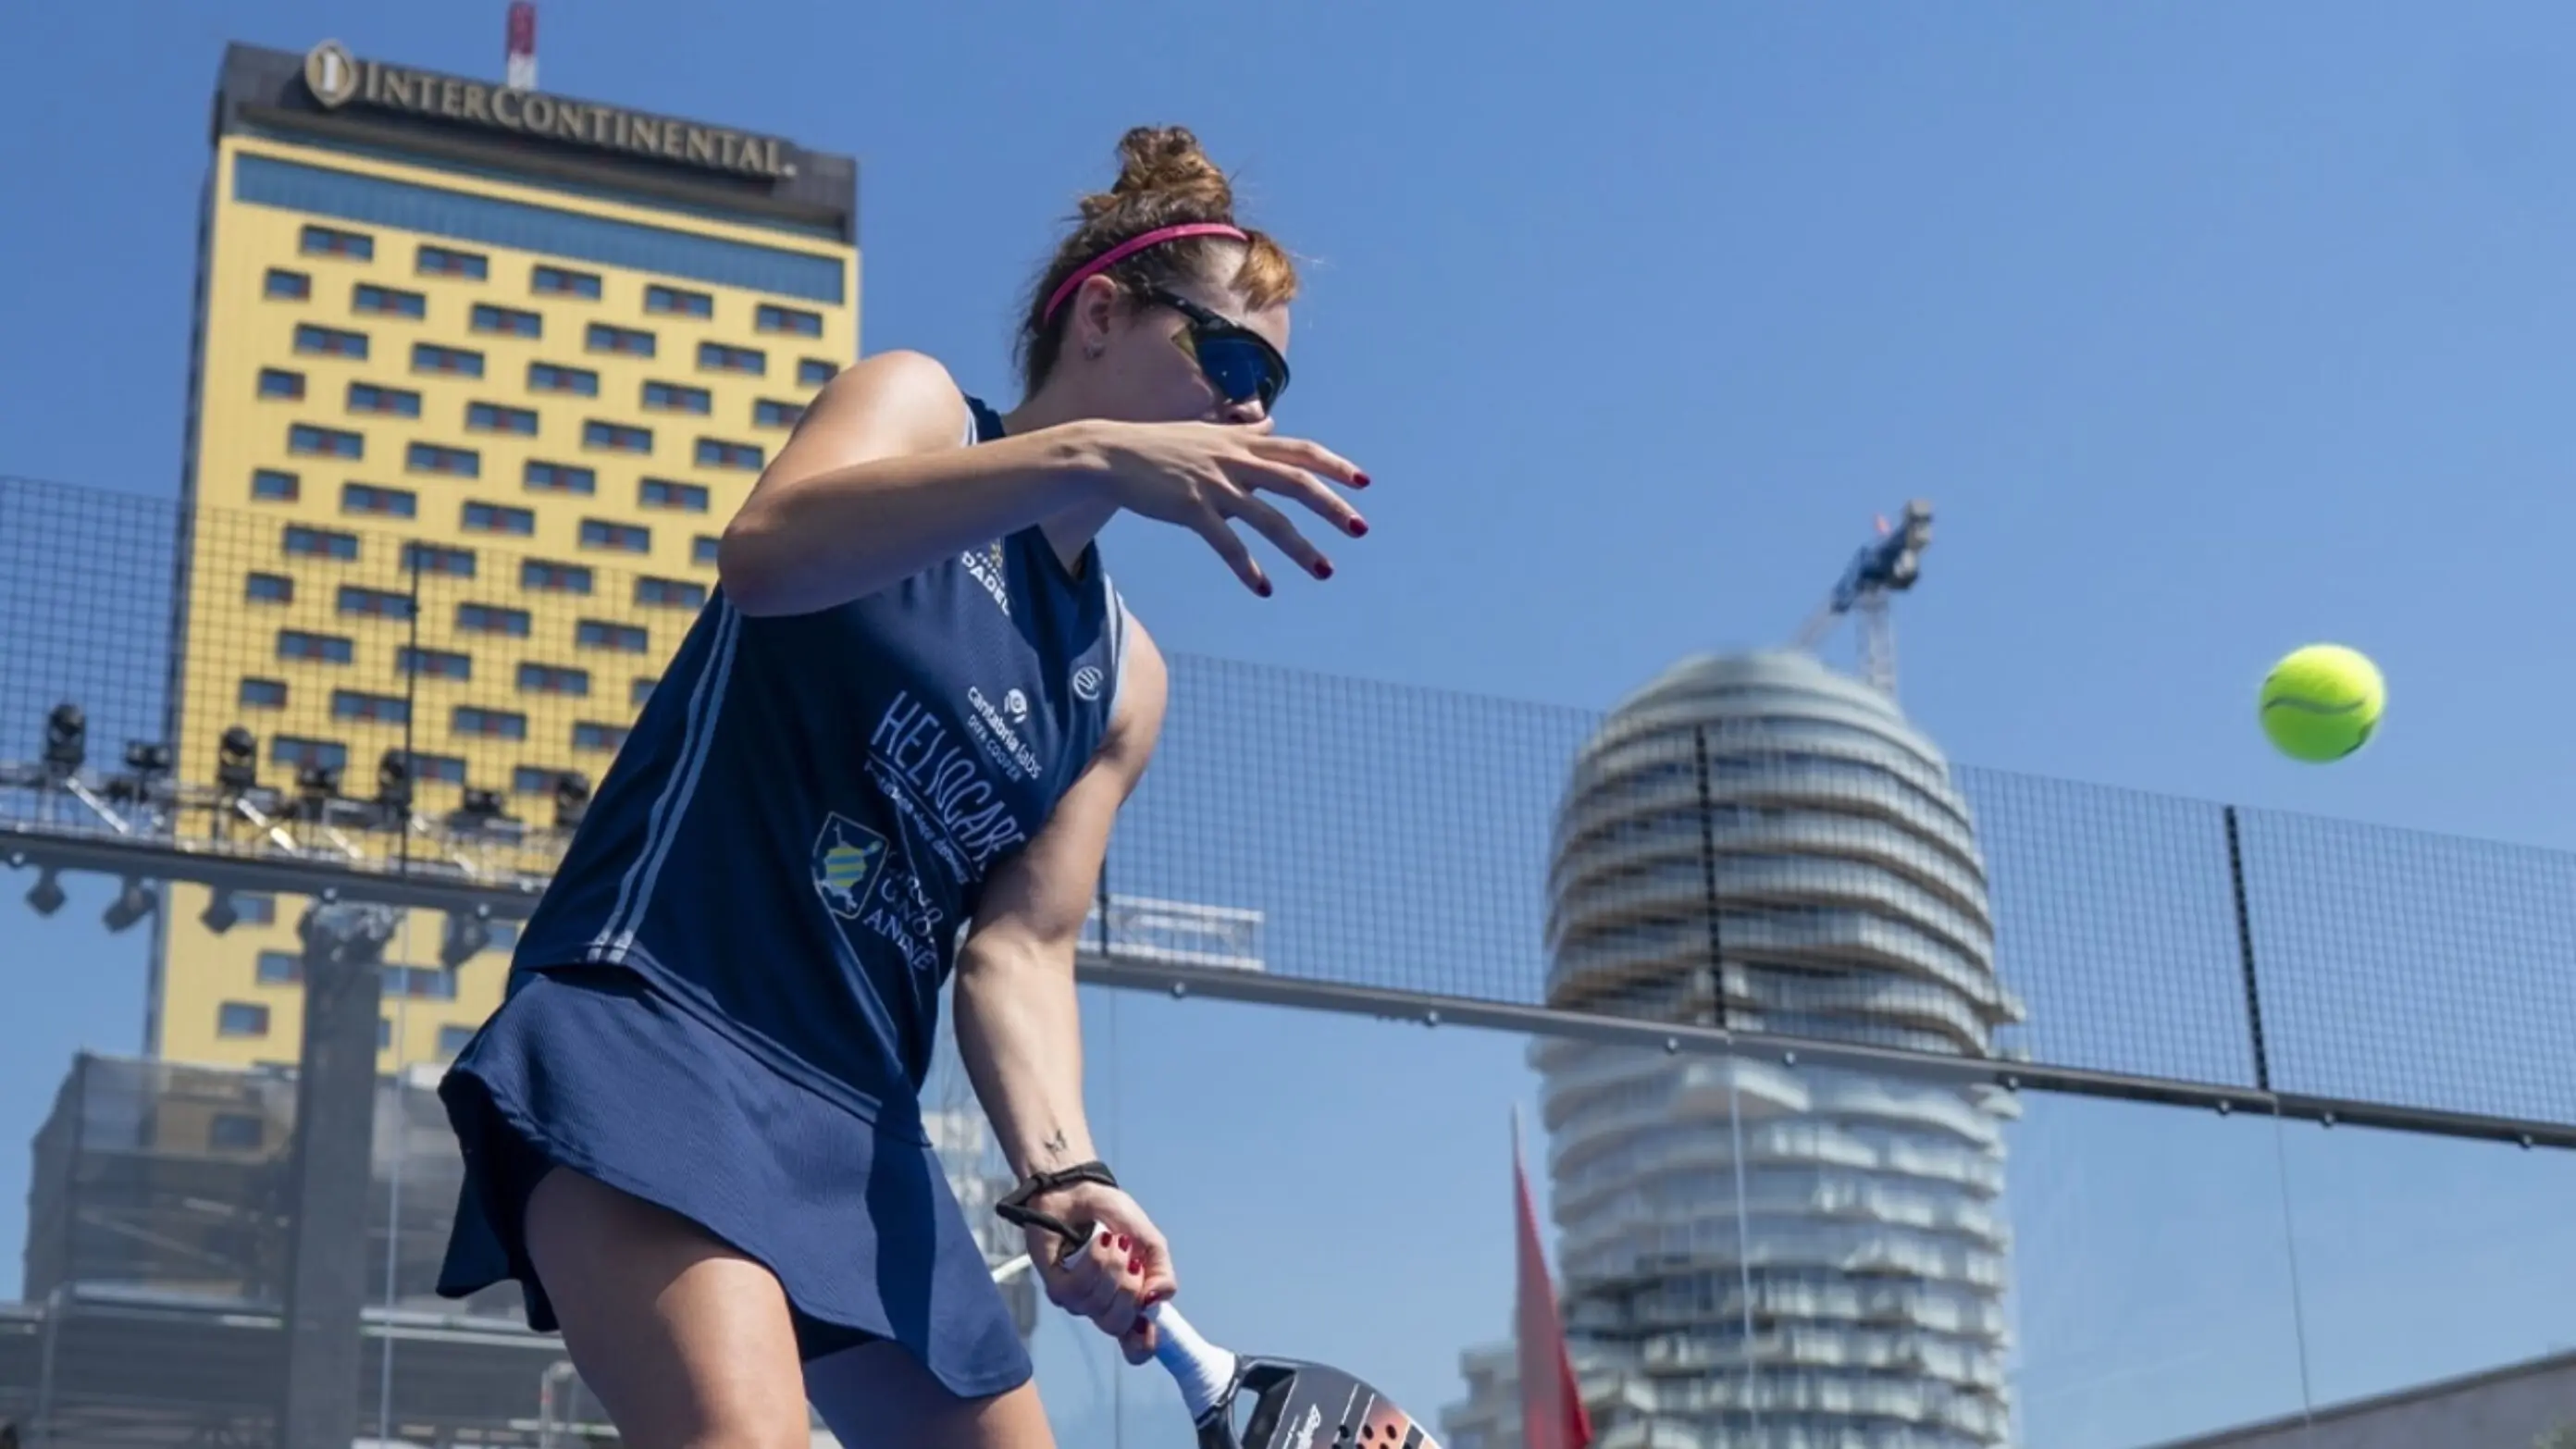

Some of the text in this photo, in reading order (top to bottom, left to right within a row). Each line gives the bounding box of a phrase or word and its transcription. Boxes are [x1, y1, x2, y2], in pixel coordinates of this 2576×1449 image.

[364, 61, 783, 176] INTERCONTINENTAL
[968, 686, 1043, 780] cantabria labs
[985, 739, 1022, 783] COOPER
